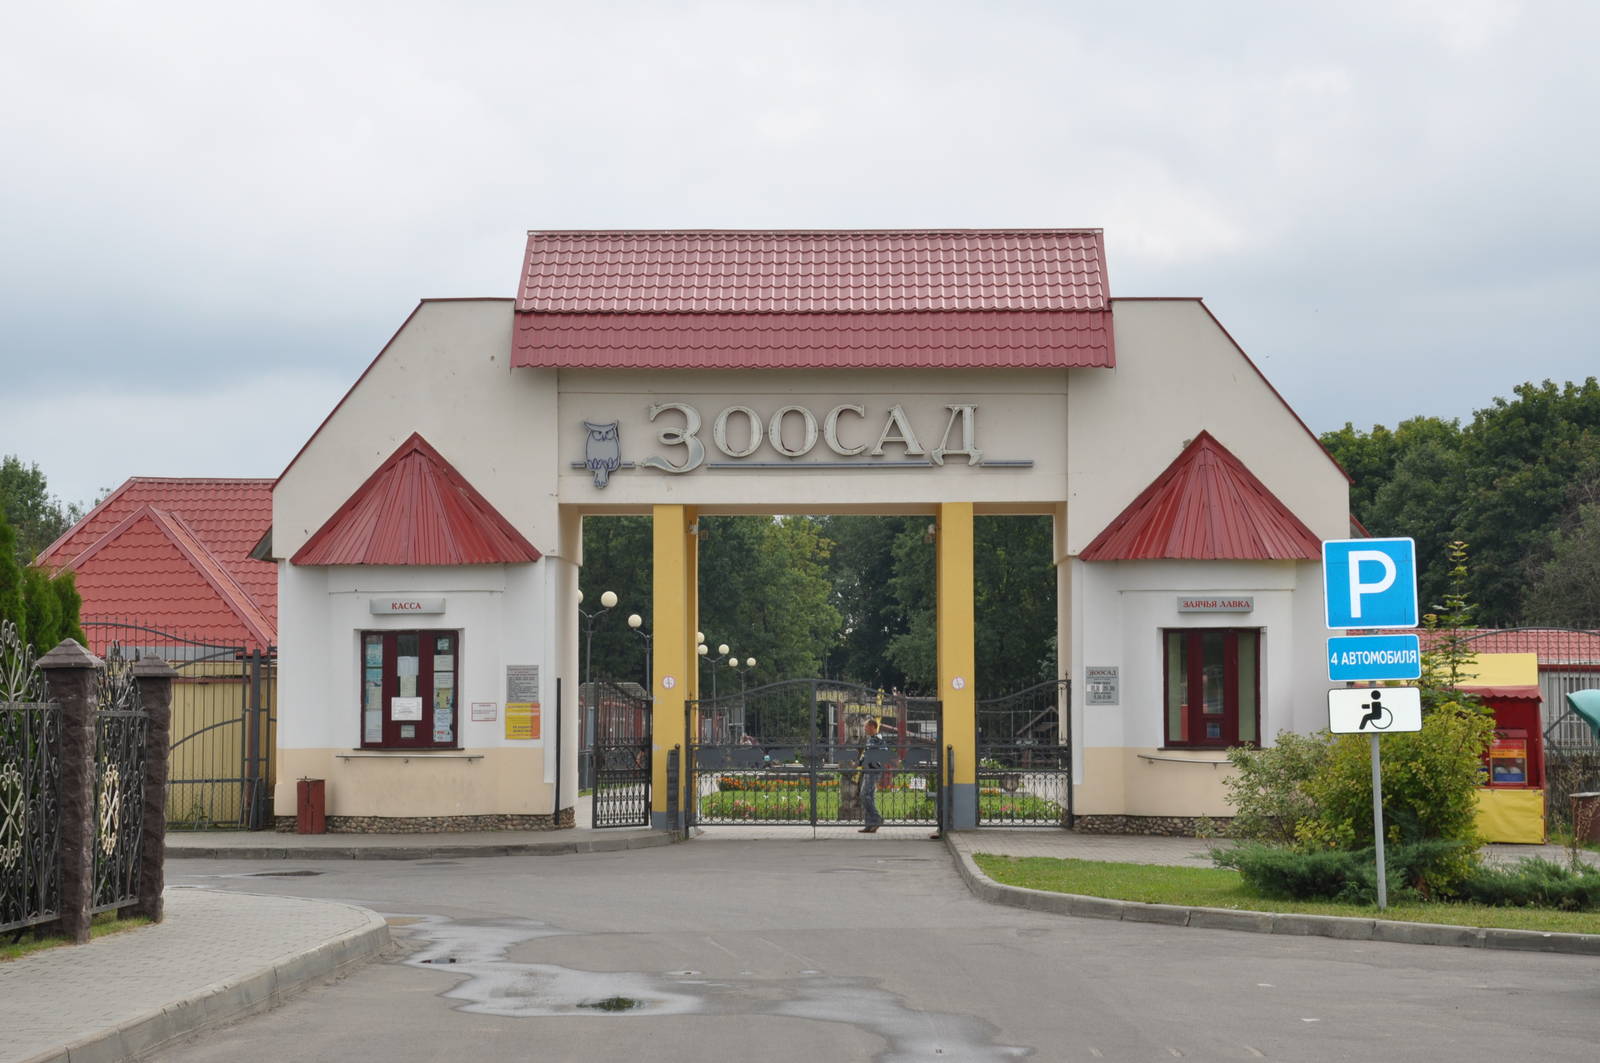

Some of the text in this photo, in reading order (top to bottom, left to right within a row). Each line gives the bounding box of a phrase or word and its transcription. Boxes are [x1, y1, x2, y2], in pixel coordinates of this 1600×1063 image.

[643, 402, 985, 475] ЗООСАД
[1348, 550, 1397, 618] P
[391, 601, 422, 610] КАССА
[1183, 600, 1251, 608] ЗАЯЧЬЯ ЛАВКА
[1330, 650, 1417, 666] 4 АВТОМОБИЛЯ
